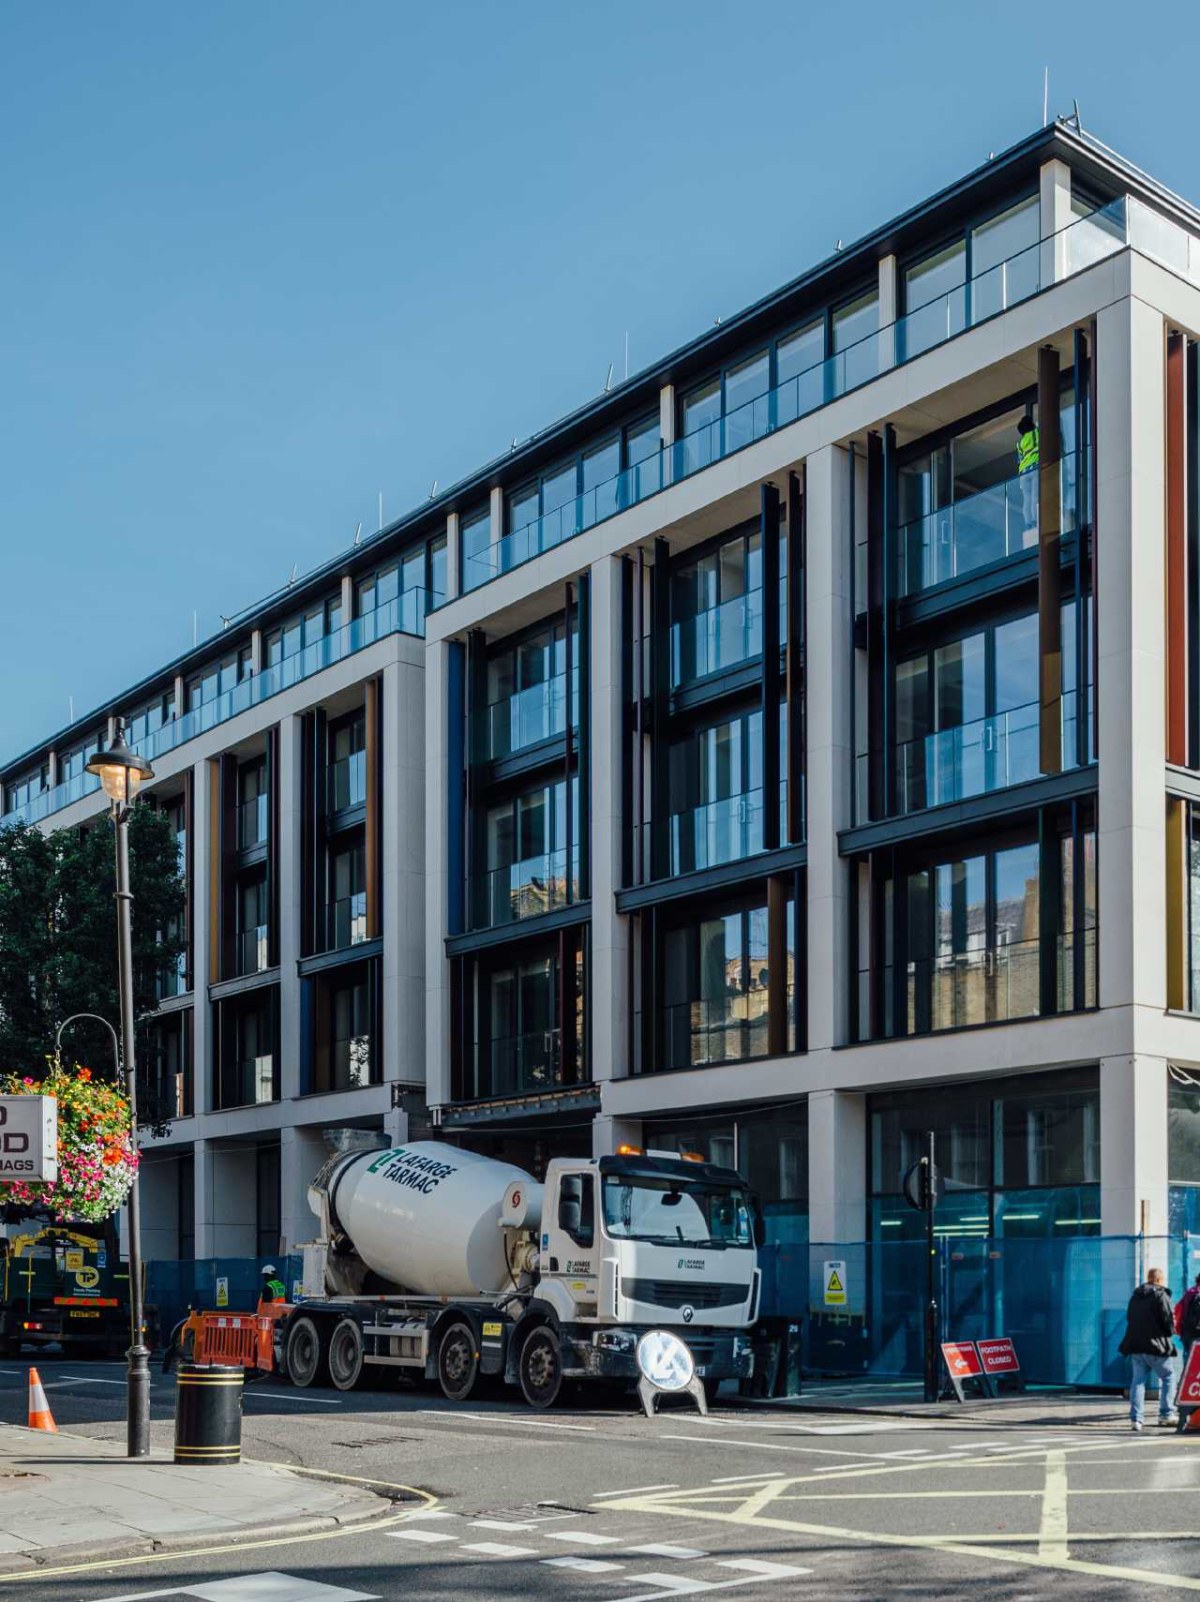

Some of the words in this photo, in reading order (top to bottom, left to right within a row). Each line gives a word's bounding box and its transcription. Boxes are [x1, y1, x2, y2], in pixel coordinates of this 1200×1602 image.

[0, 1133, 29, 1153] D
[0, 1160, 34, 1171] AGS
[396, 1152, 458, 1179] LAFARGE
[382, 1163, 440, 1194] TARMAC
[80, 1274, 96, 1283] TP
[980, 1344, 1012, 1354] FOOTPATH
[987, 1355, 1012, 1365] CLOSED
